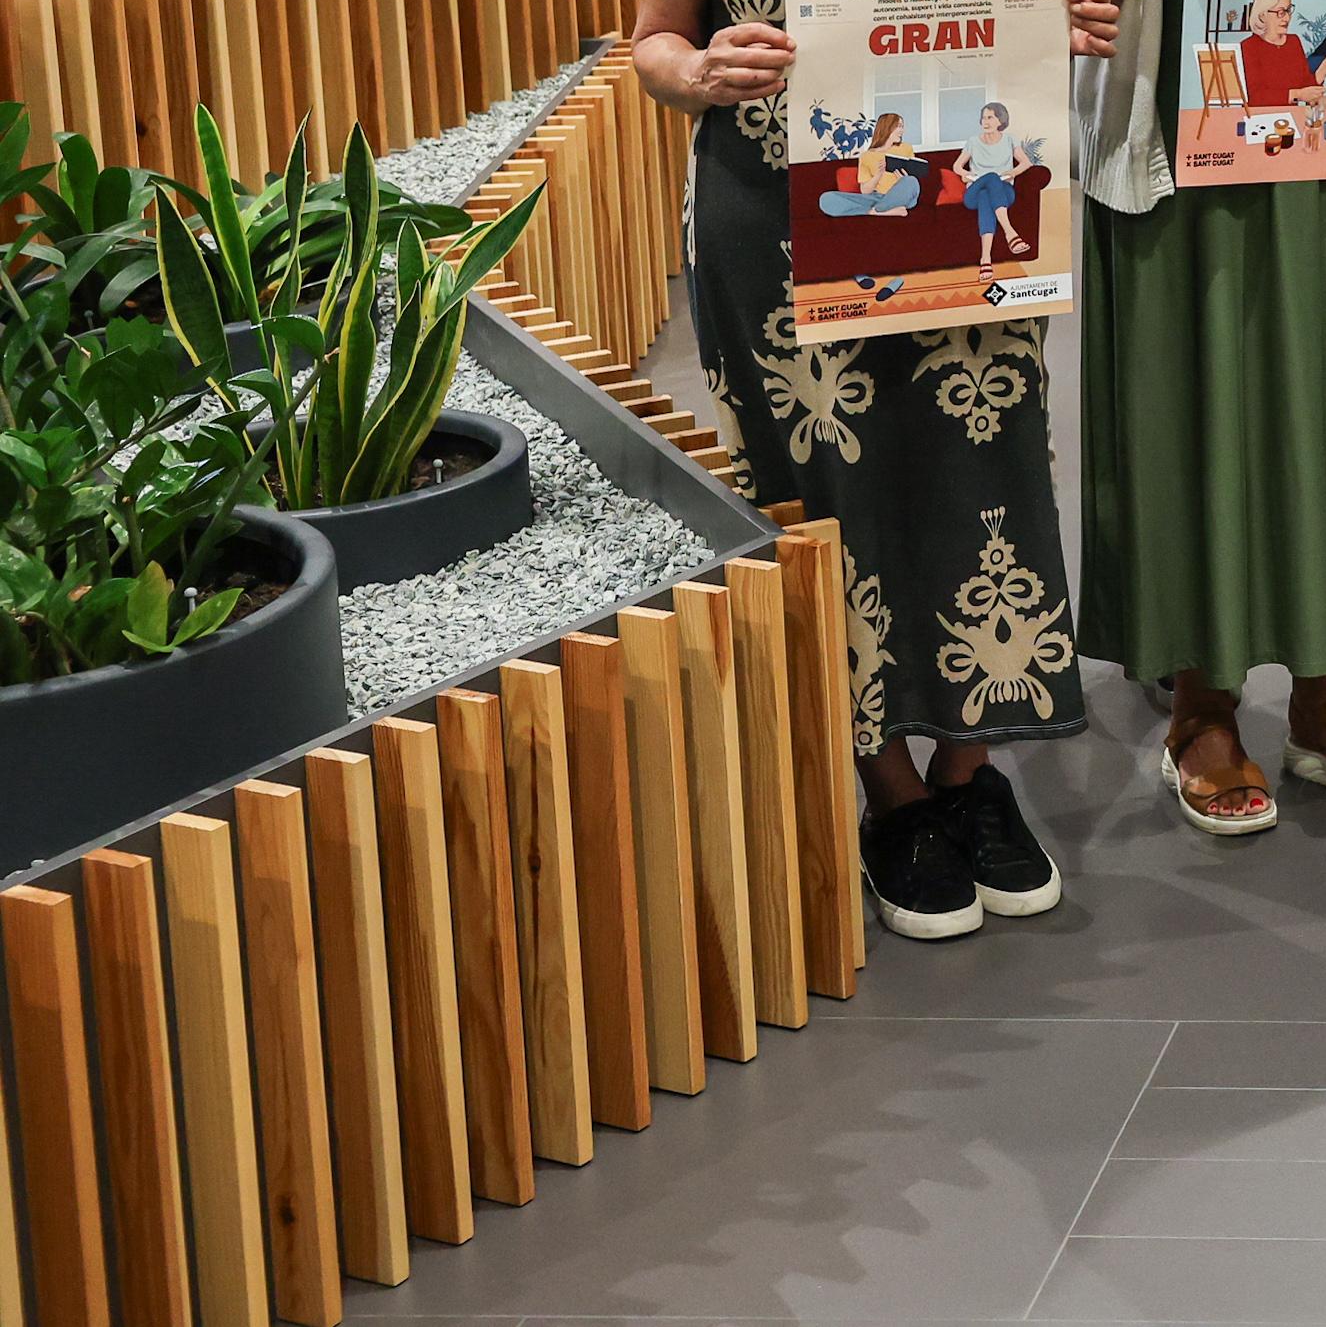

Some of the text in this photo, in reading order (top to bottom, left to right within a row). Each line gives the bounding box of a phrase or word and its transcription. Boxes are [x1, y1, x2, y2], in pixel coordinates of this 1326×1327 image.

[869, 18, 995, 56] GRAN
[1010, 287, 1059, 299] SantCugat
[817, 302, 867, 314] SANT CUGAT
[818, 309, 868, 321] SANT CUGAT
